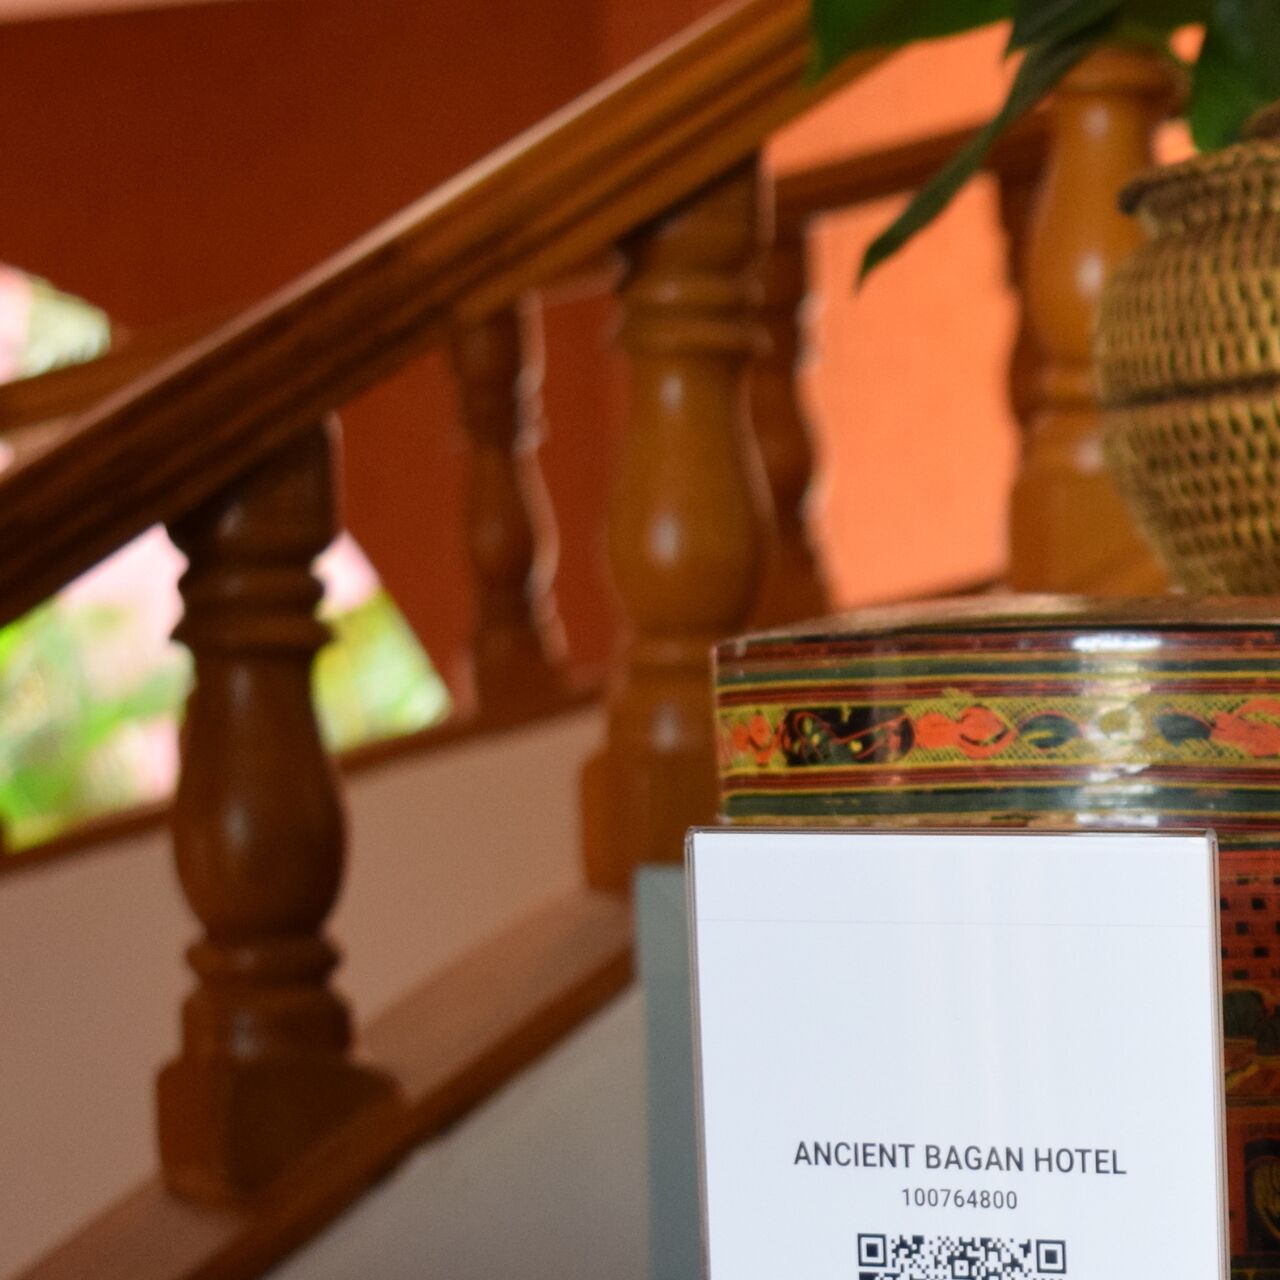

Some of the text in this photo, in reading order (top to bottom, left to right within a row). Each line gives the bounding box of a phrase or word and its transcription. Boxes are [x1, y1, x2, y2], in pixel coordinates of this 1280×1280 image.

[793, 1141, 1127, 1175] ANCIENT BAGAN HOTEL
[902, 1188, 1018, 1210] 100764800
